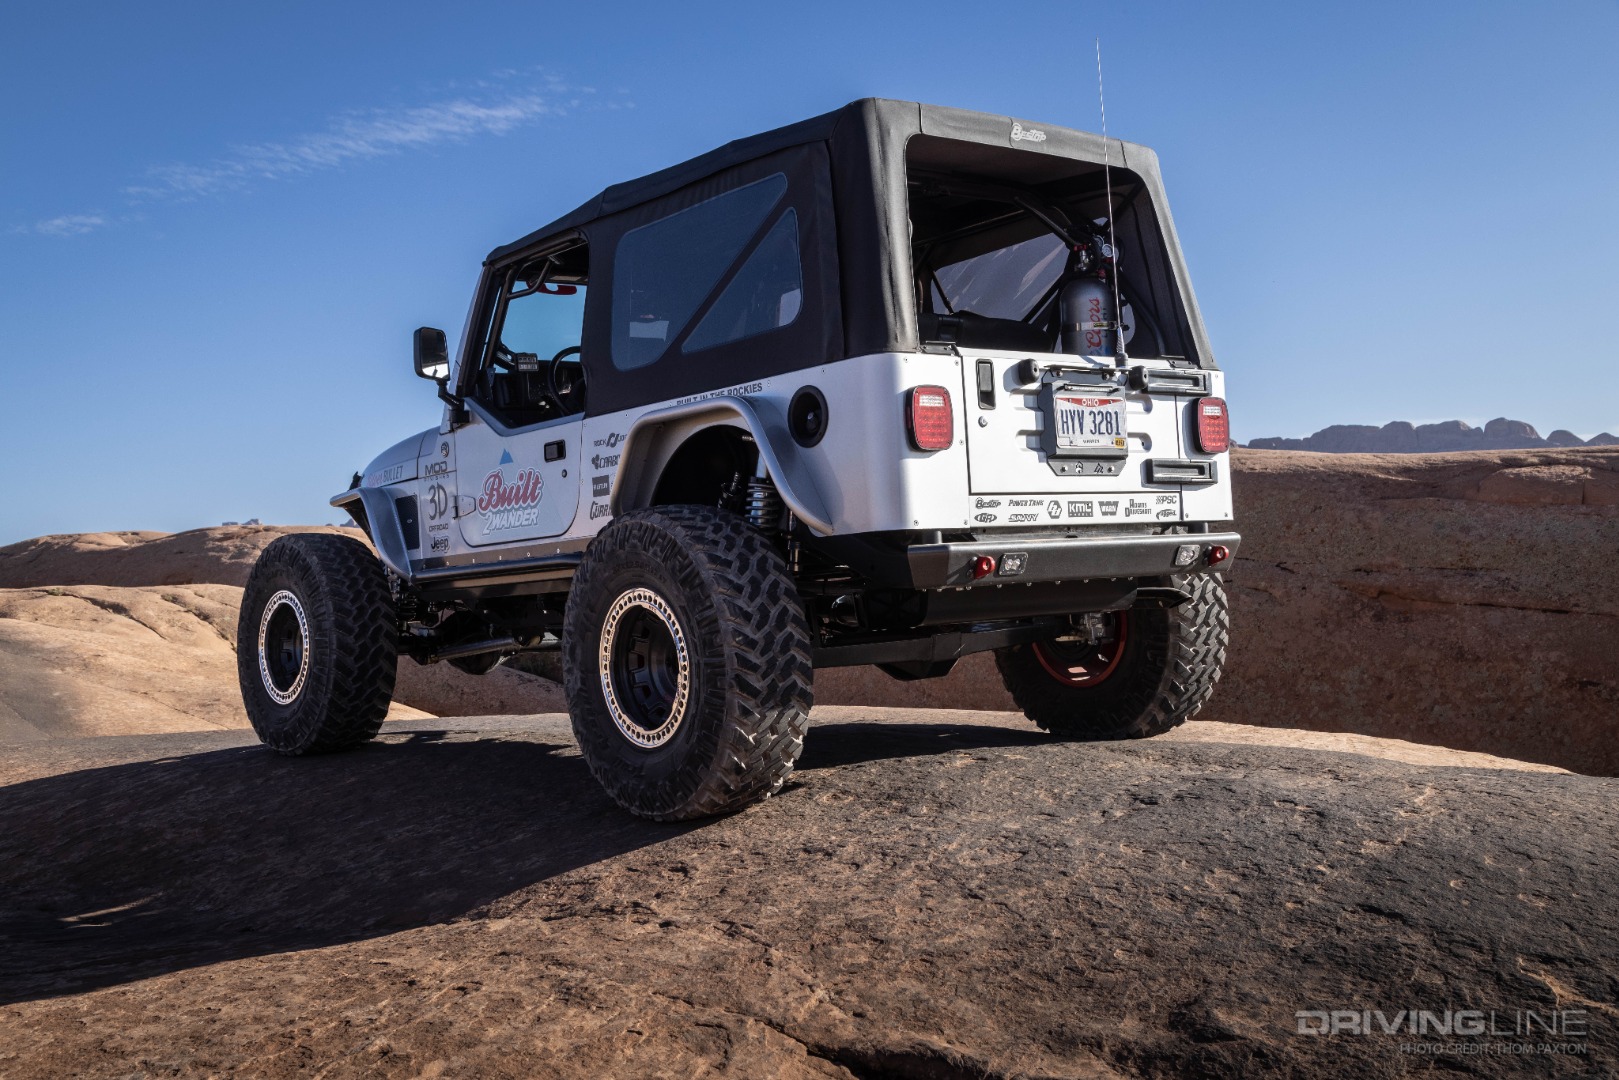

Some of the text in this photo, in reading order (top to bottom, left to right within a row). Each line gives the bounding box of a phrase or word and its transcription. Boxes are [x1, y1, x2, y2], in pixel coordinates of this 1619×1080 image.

[727, 382, 763, 397] ROCKIES
[1060, 409, 1121, 436] HYV 3281
[428, 482, 448, 520] 3D
[478, 468, 543, 513] Built
[482, 508, 540, 536] 2WANDER
[431, 536, 449, 551] Jeep
